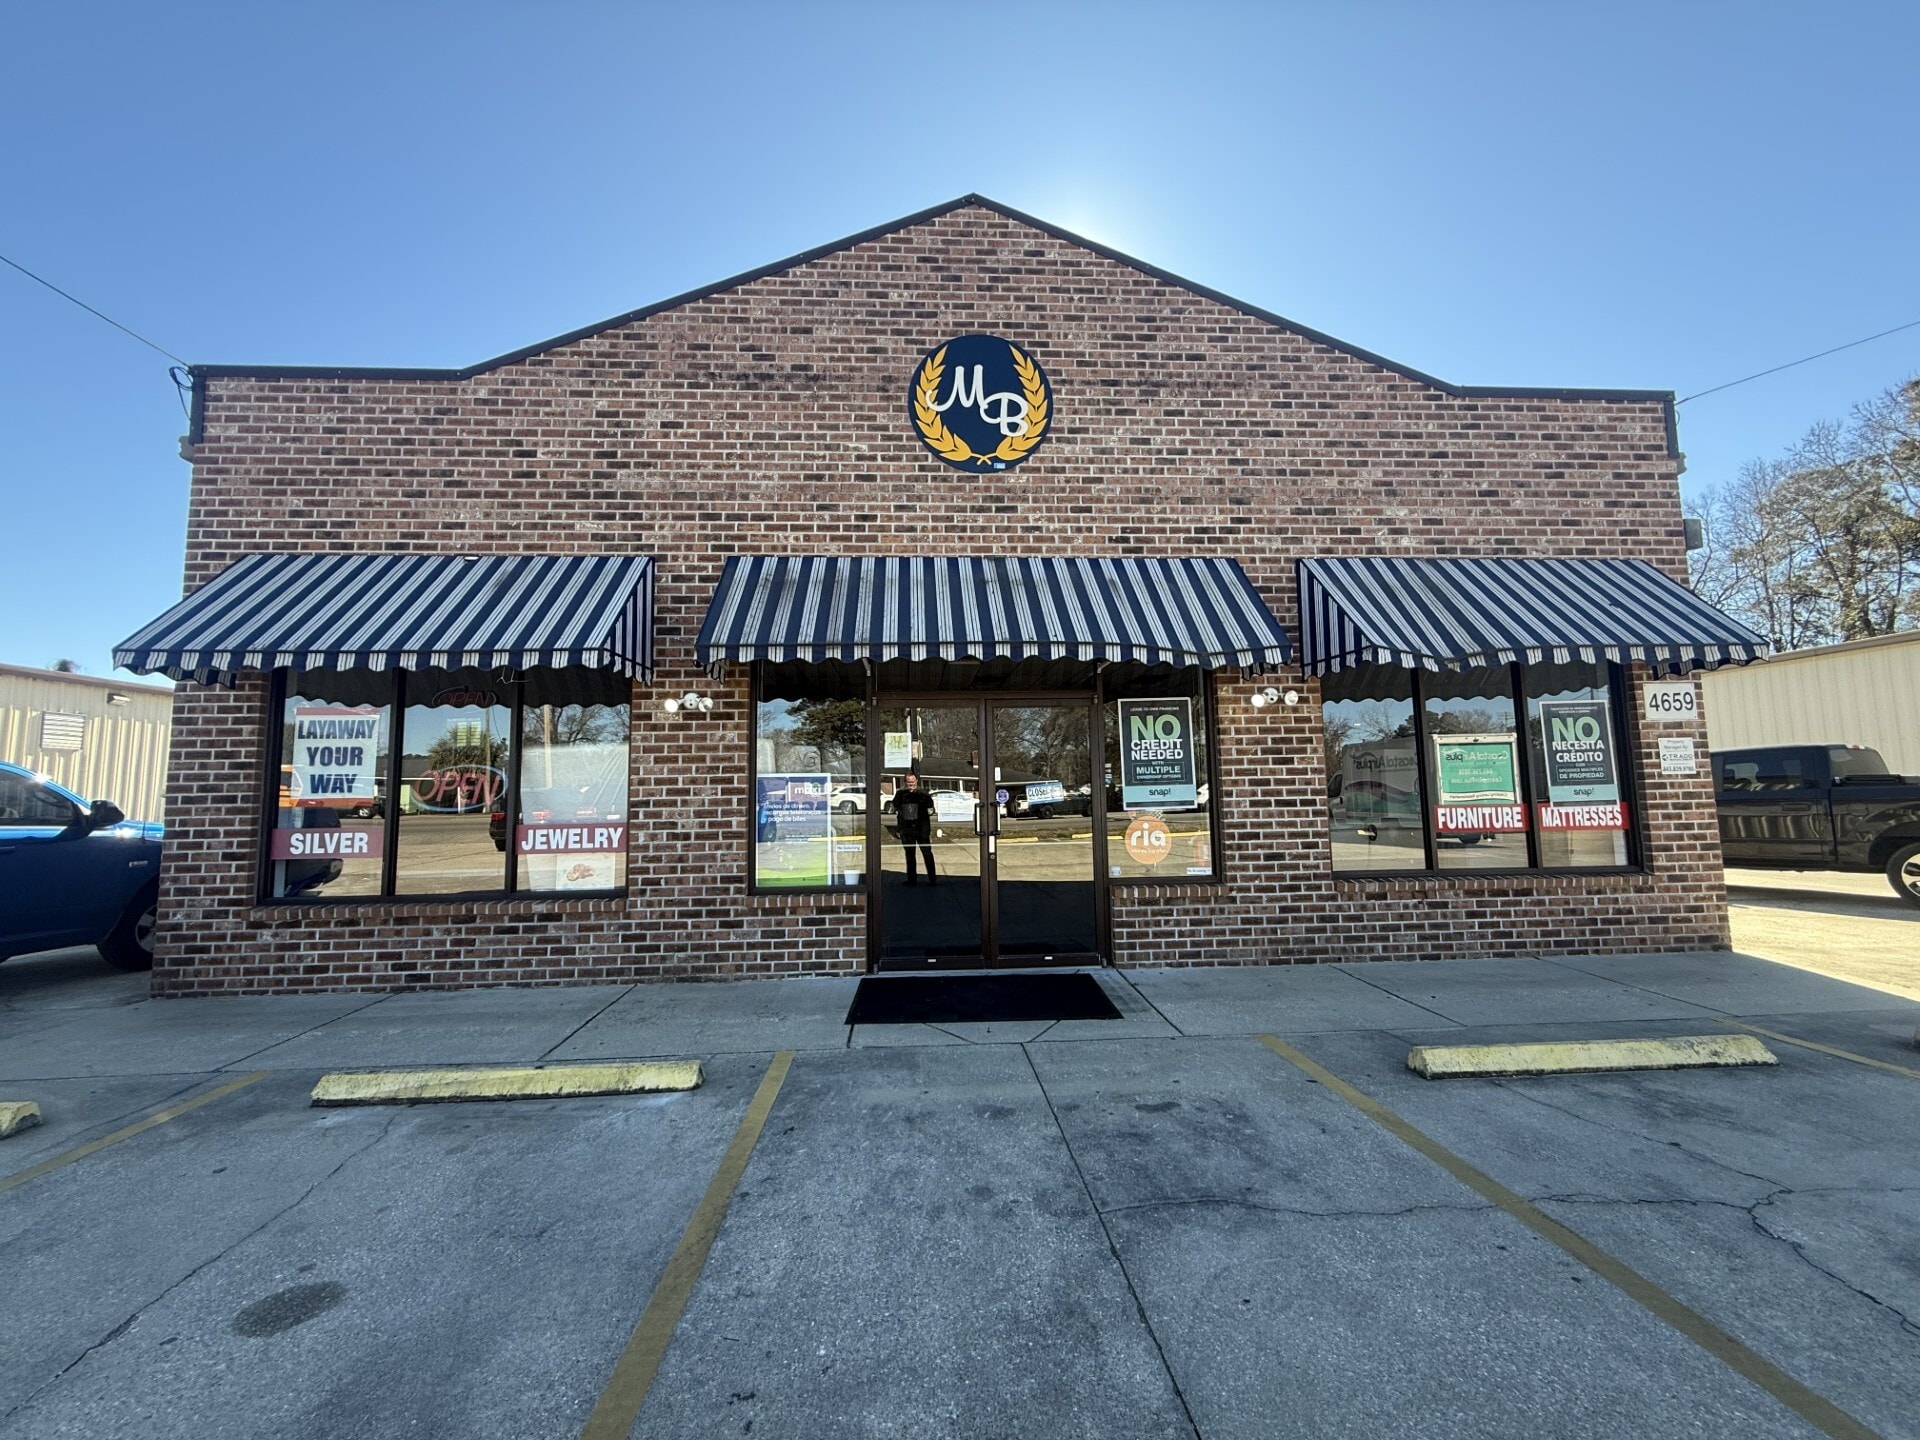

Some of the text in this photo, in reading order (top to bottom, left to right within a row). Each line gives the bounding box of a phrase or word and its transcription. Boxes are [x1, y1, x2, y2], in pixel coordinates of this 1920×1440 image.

[1649, 692, 1694, 712] 4659
[297, 719, 377, 740] LAYAWAY
[1130, 714, 1181, 740] NO
[1551, 716, 1600, 742] NO
[1131, 739, 1183, 750] CREDIT
[1131, 749, 1184, 760] NEEDED
[1552, 740, 1605, 751] NECESITA
[306, 746, 363, 767] YOUR
[1556, 750, 1604, 762] CRÉDITO
[1136, 766, 1181, 774] MULTIPLE
[310, 774, 358, 794] WAY
[413, 769, 500, 806] OPEN
[1148, 787, 1171, 797] snap!
[1573, 788, 1595, 797] snap!
[1437, 806, 1523, 829] FURNITURE
[1541, 806, 1622, 827] MATTRESSES
[290, 832, 369, 855] SILVER
[521, 827, 623, 851] JEWELRY
[1130, 822, 1166, 846] ria
